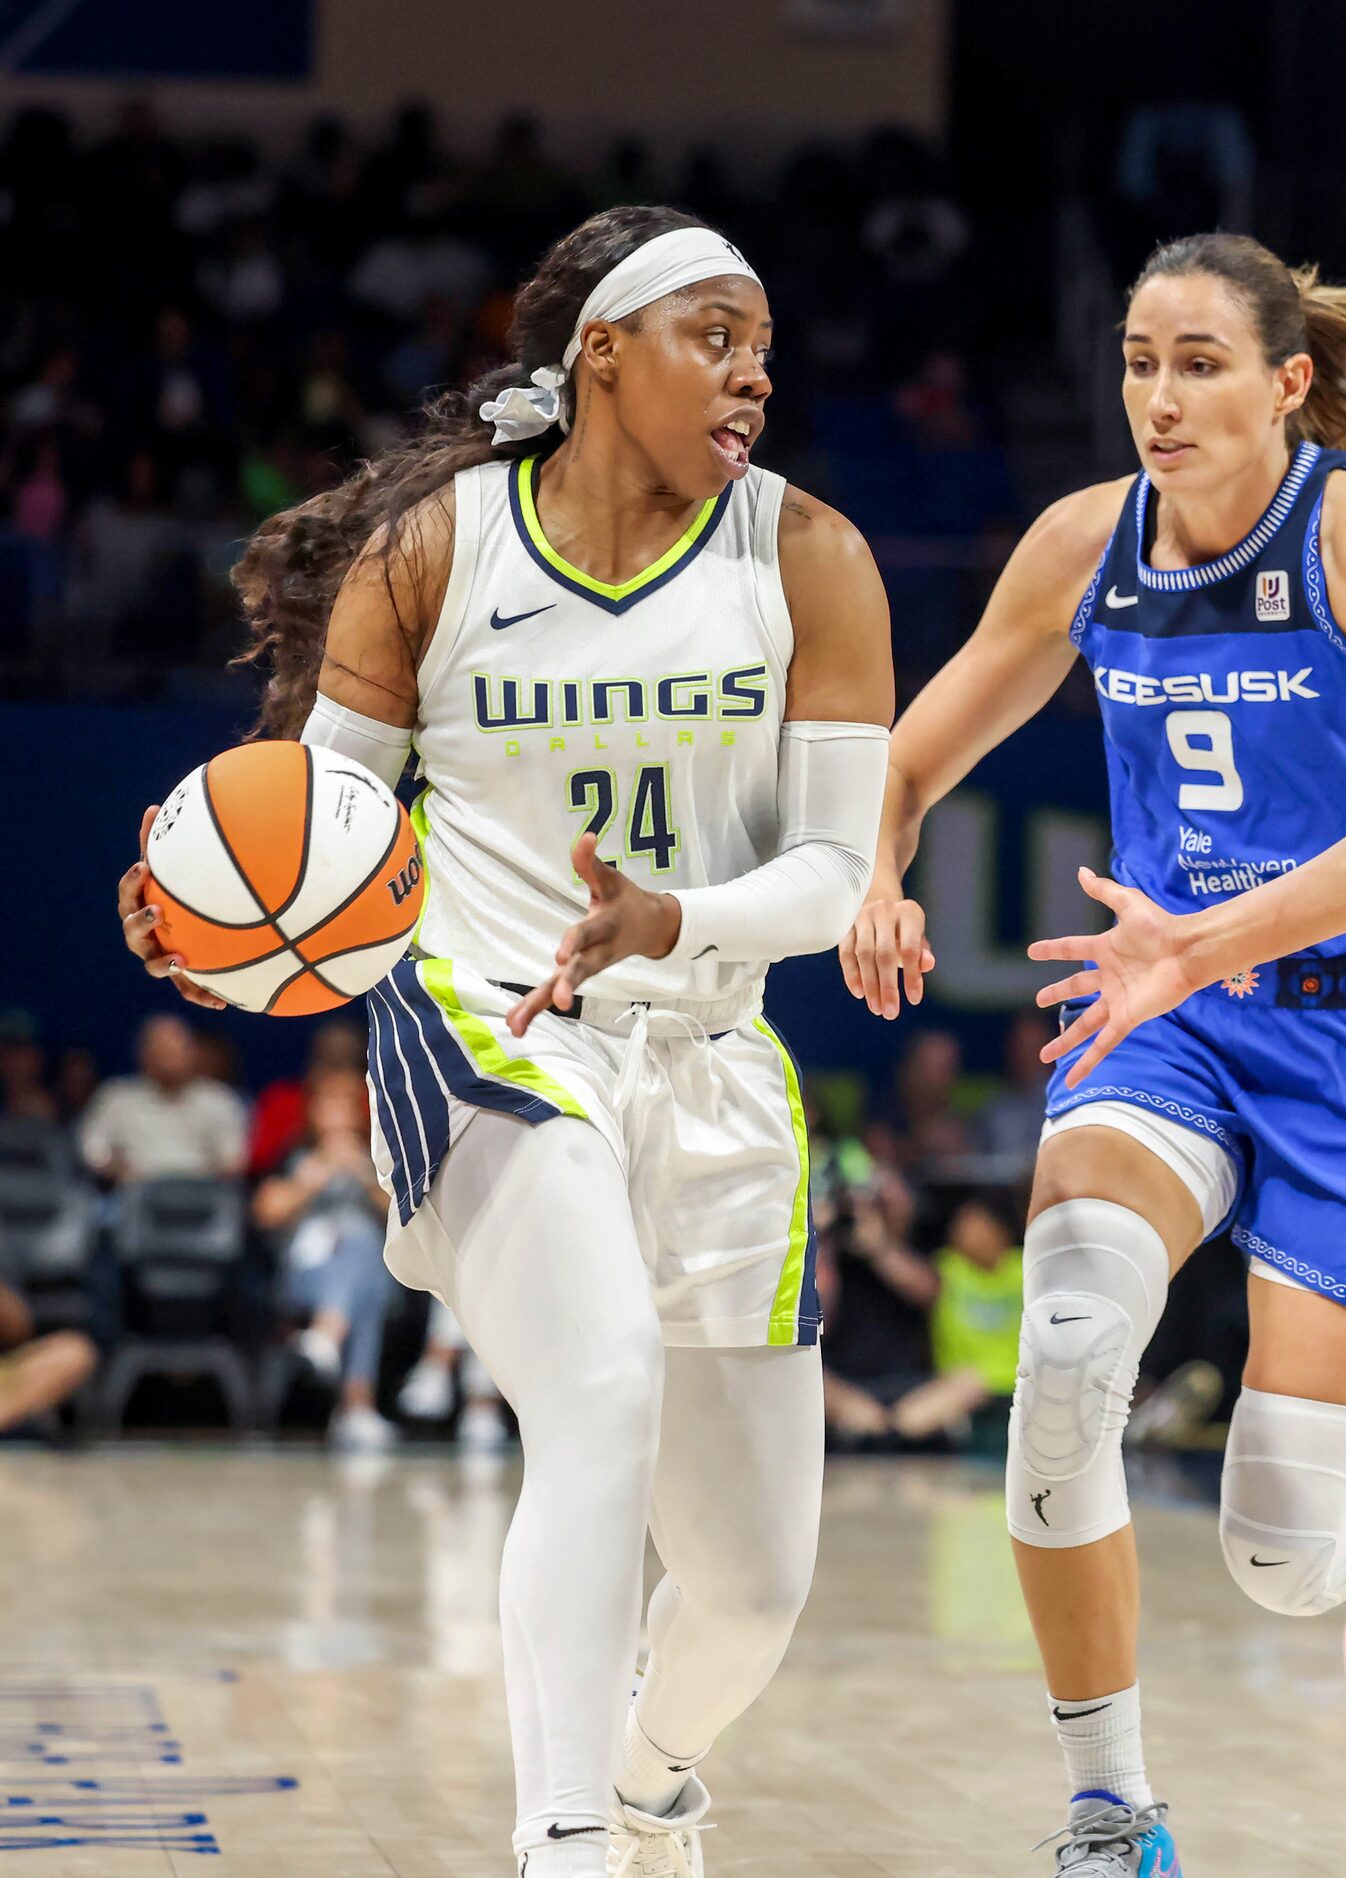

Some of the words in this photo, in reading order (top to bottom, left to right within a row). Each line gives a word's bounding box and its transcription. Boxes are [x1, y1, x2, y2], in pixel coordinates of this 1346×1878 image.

[1257, 597, 1287, 611] Post
[471, 660, 769, 733] WINGS
[504, 730, 737, 757] DALLAS
[1165, 709, 1244, 812] 9
[566, 761, 682, 885] 24
[1179, 825, 1213, 854] Yale
[1188, 868, 1264, 896] Health
